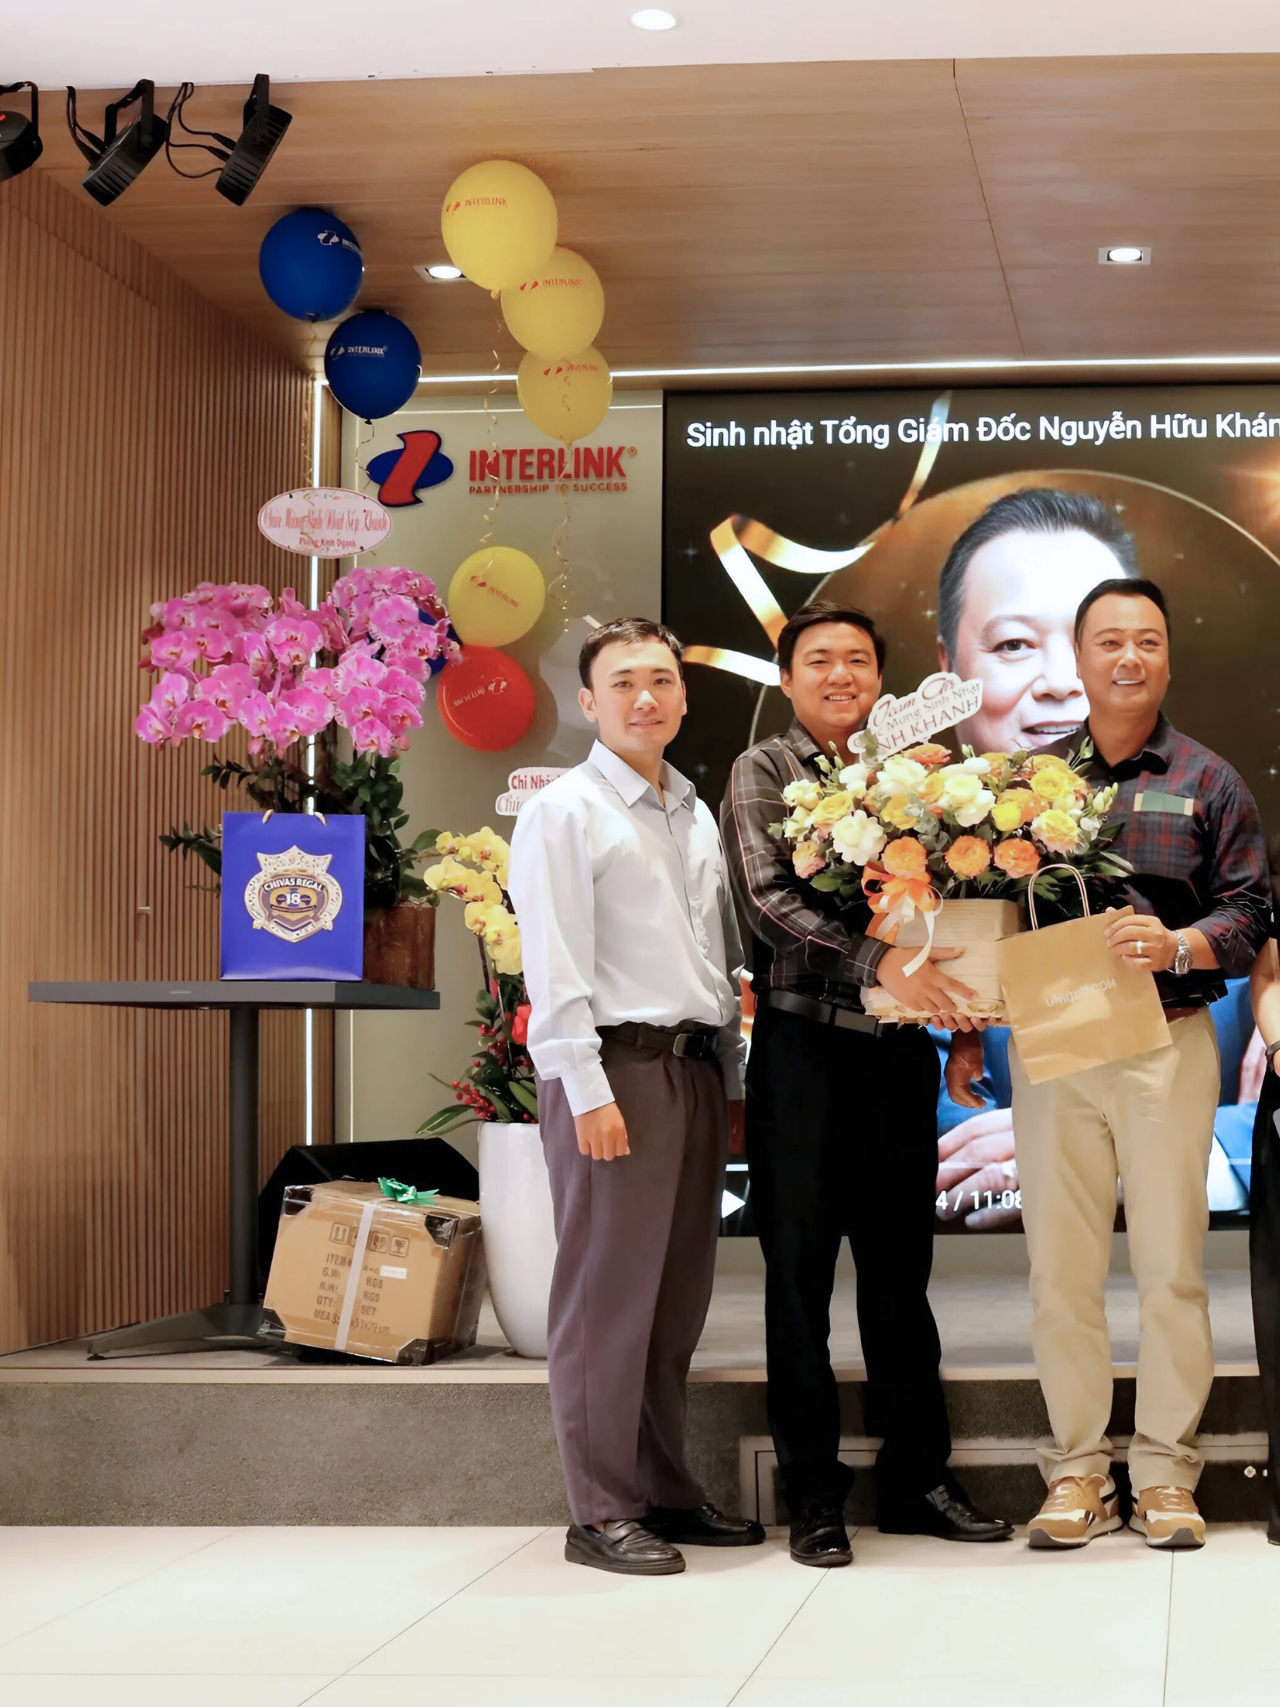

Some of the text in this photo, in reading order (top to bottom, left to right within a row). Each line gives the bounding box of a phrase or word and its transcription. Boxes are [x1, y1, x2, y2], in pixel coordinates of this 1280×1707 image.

[686, 422, 746, 448] Sinh
[753, 419, 814, 450] nhật
[819, 415, 890, 449] Tổng
[897, 417, 969, 443] Giám
[976, 412, 1031, 442] Đốc
[1039, 410, 1142, 446] Nguyễn
[1150, 413, 1208, 439] Hữu
[469, 446, 627, 482] INTERLINK
[469, 484, 549, 495] PARTNERSHIP
[573, 481, 628, 493] SUCCESS
[510, 774, 528, 790] Chi
[263, 877, 323, 892] CHIVAS REGAL
[285, 892, 301, 905] 18
[360, 1304, 378, 1317] SET
